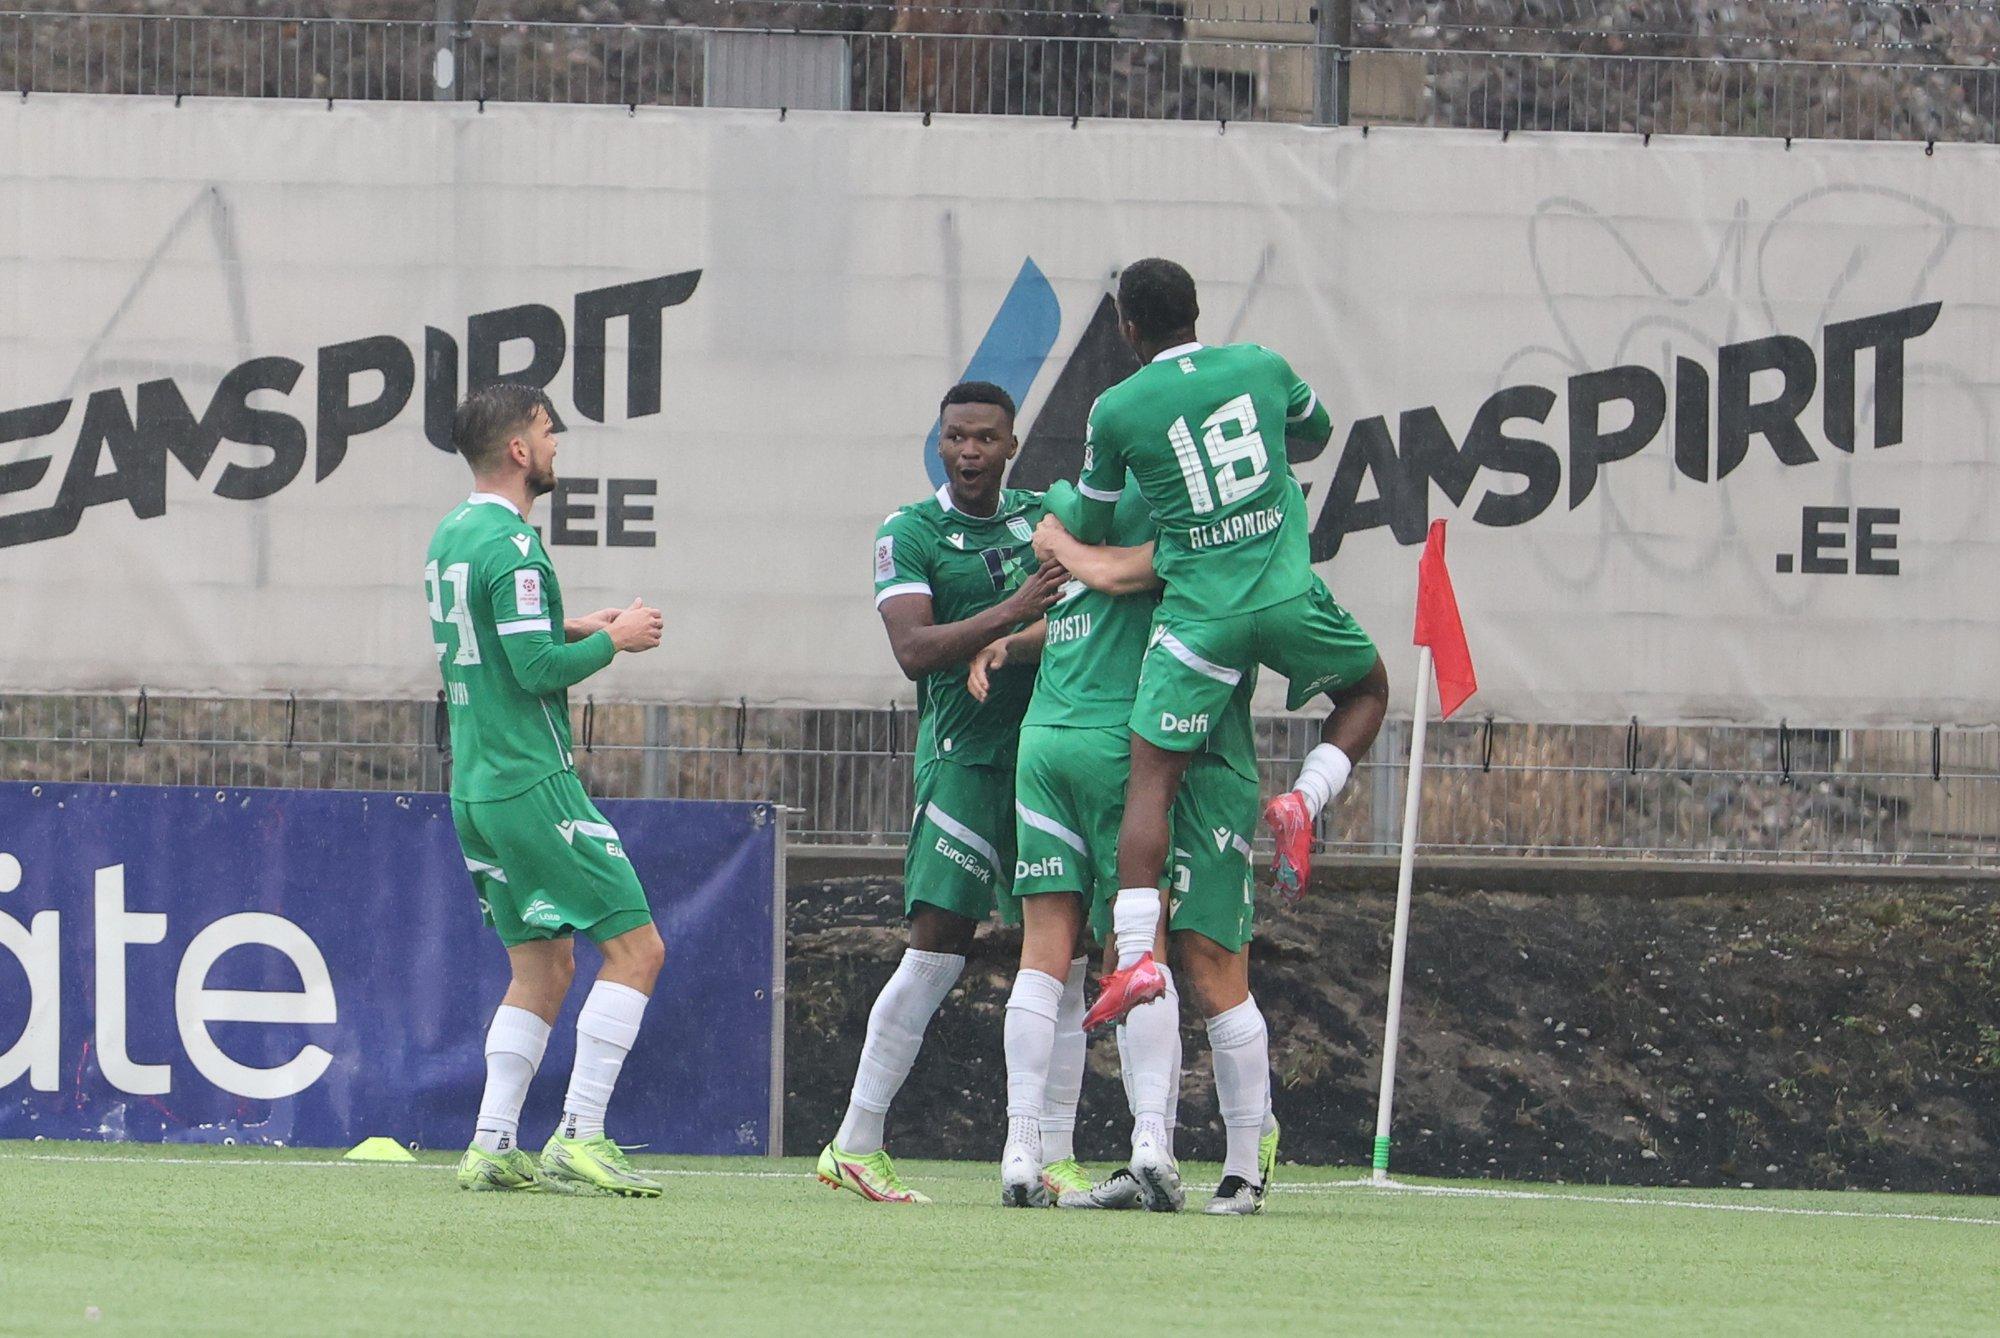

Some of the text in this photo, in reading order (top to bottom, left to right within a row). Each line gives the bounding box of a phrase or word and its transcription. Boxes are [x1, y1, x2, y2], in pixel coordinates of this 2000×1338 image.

[1167, 393, 1270, 516] 18
[1287, 301, 1943, 563] AMSPIRIT
[533, 478, 657, 547] EE
[1776, 506, 1901, 575] .EE
[1046, 613, 1091, 646] EPISTU
[1160, 712, 1209, 733] Delfi
[934, 836, 991, 884] EuroPark
[1015, 856, 1064, 880] Delfi
